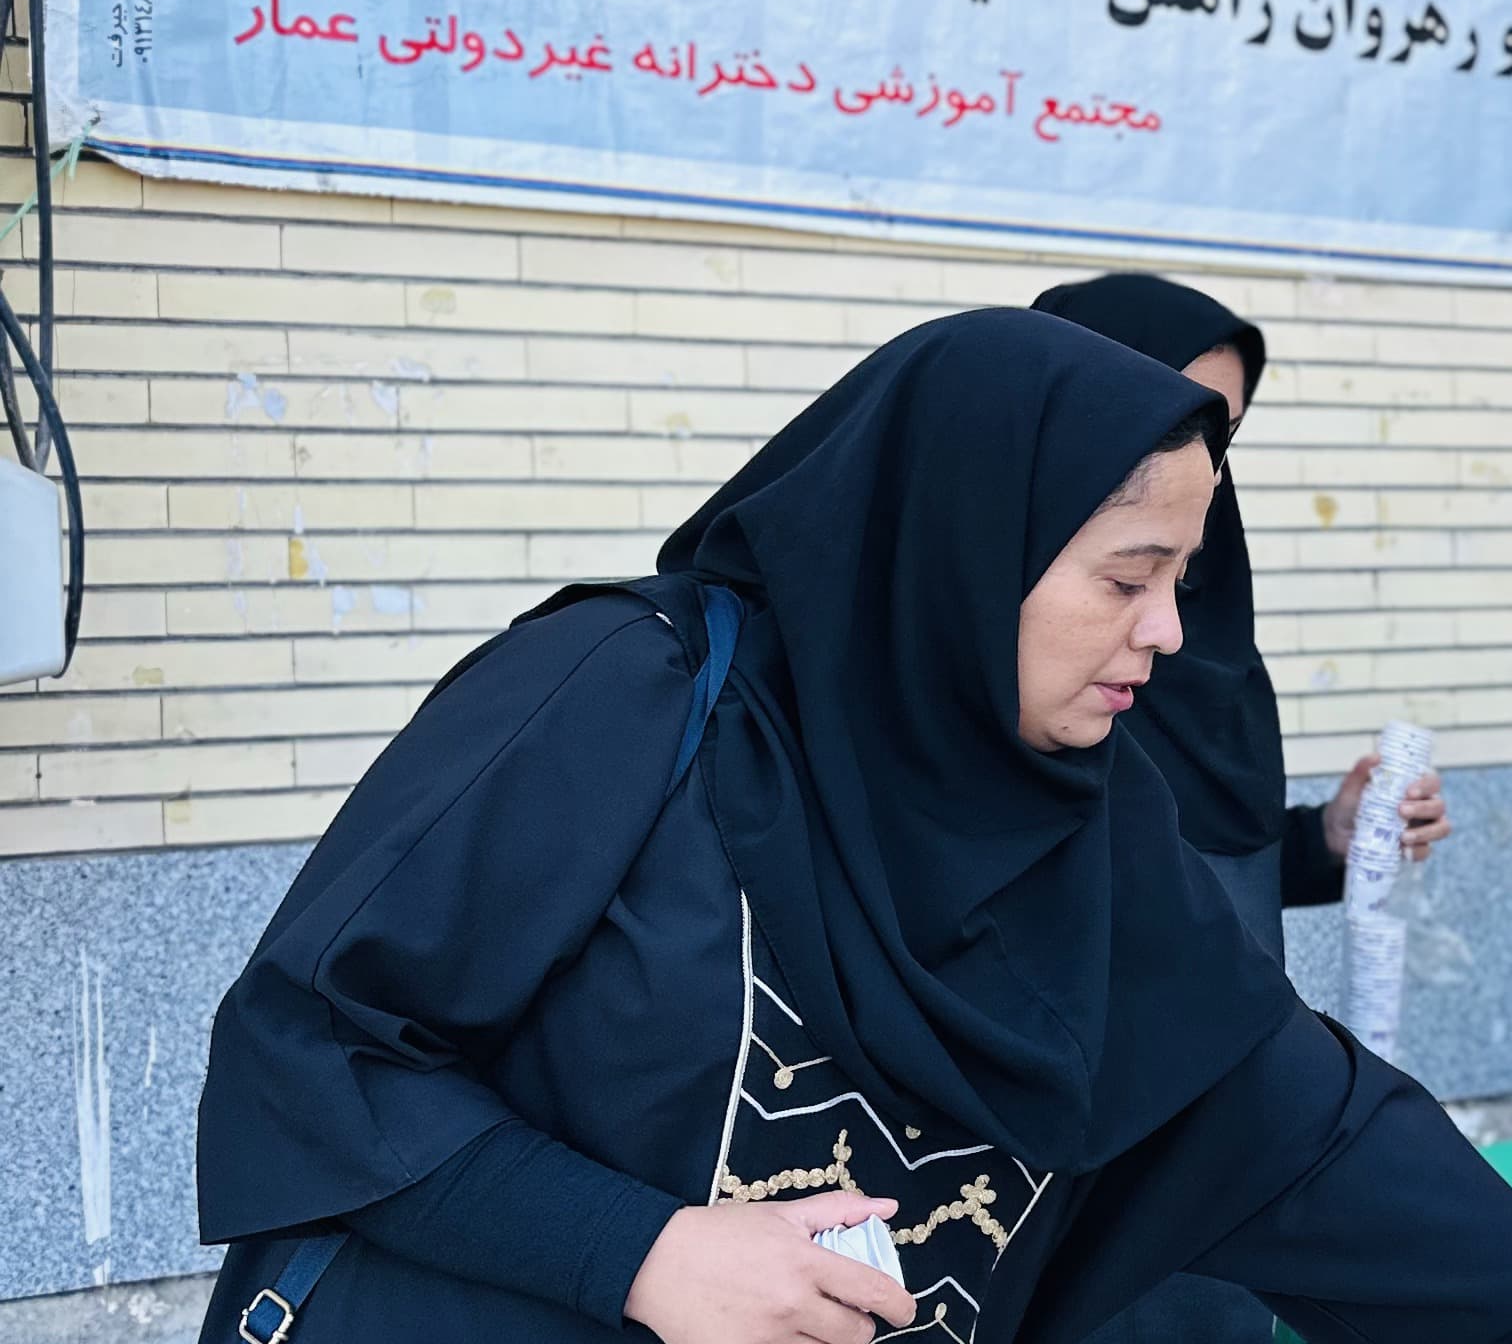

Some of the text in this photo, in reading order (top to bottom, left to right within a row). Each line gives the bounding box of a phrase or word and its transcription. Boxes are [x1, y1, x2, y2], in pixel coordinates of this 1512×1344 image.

[632, 42, 817, 96] دخترانه
[833, 68, 1024, 128] آموزشی
[1034, 95, 1161, 144] مجتمع
